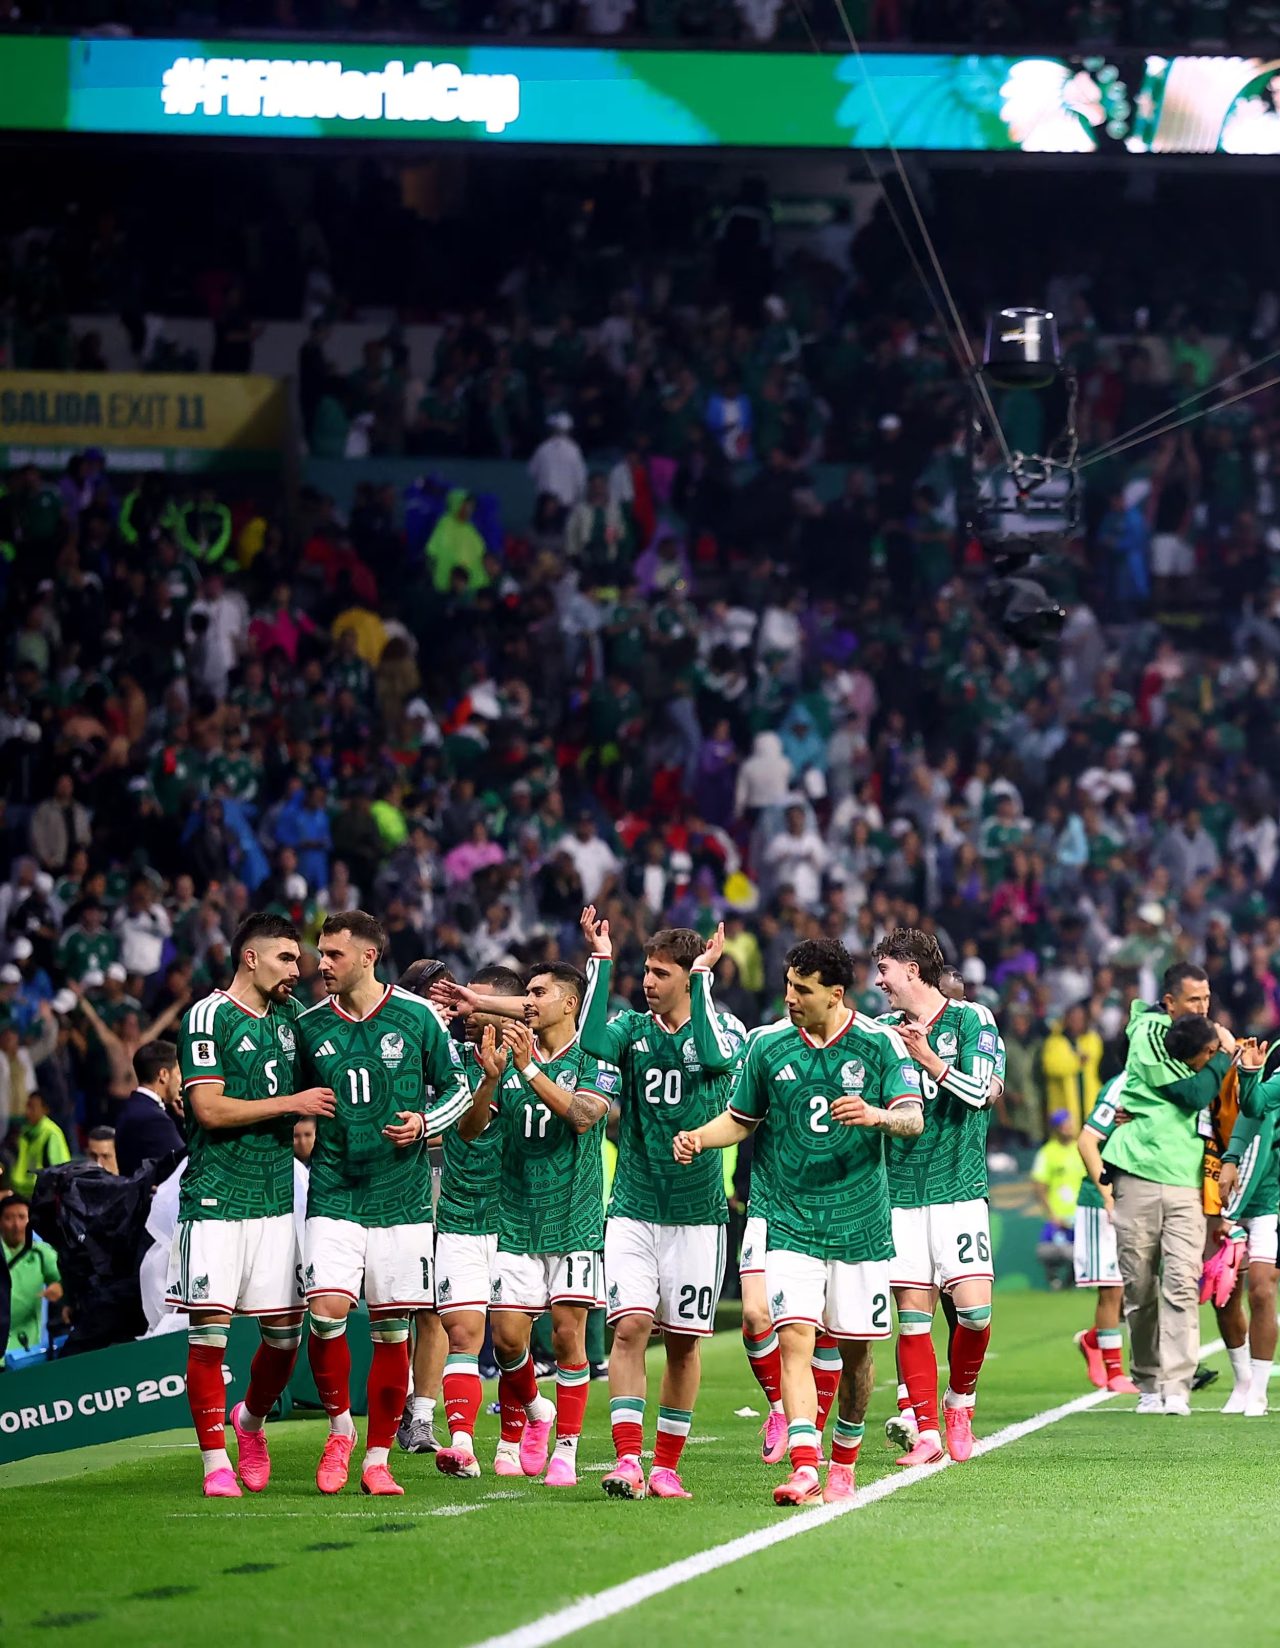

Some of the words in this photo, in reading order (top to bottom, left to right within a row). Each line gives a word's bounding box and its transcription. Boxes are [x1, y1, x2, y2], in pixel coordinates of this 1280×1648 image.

[2, 390, 100, 426] SALIDA
[108, 392, 167, 429] EXIT
[264, 1059, 278, 1096] 5
[347, 1067, 371, 1104] 11
[645, 1068, 682, 1104] 20
[524, 1103, 551, 1138] 17
[809, 1095, 829, 1133] 2
[956, 1231, 990, 1264] 26
[566, 1256, 591, 1288] 17
[678, 1284, 713, 1320] 20
[872, 1293, 888, 1328] 2
[0, 1400, 74, 1433] ORLD
[78, 1386, 132, 1416] CUP
